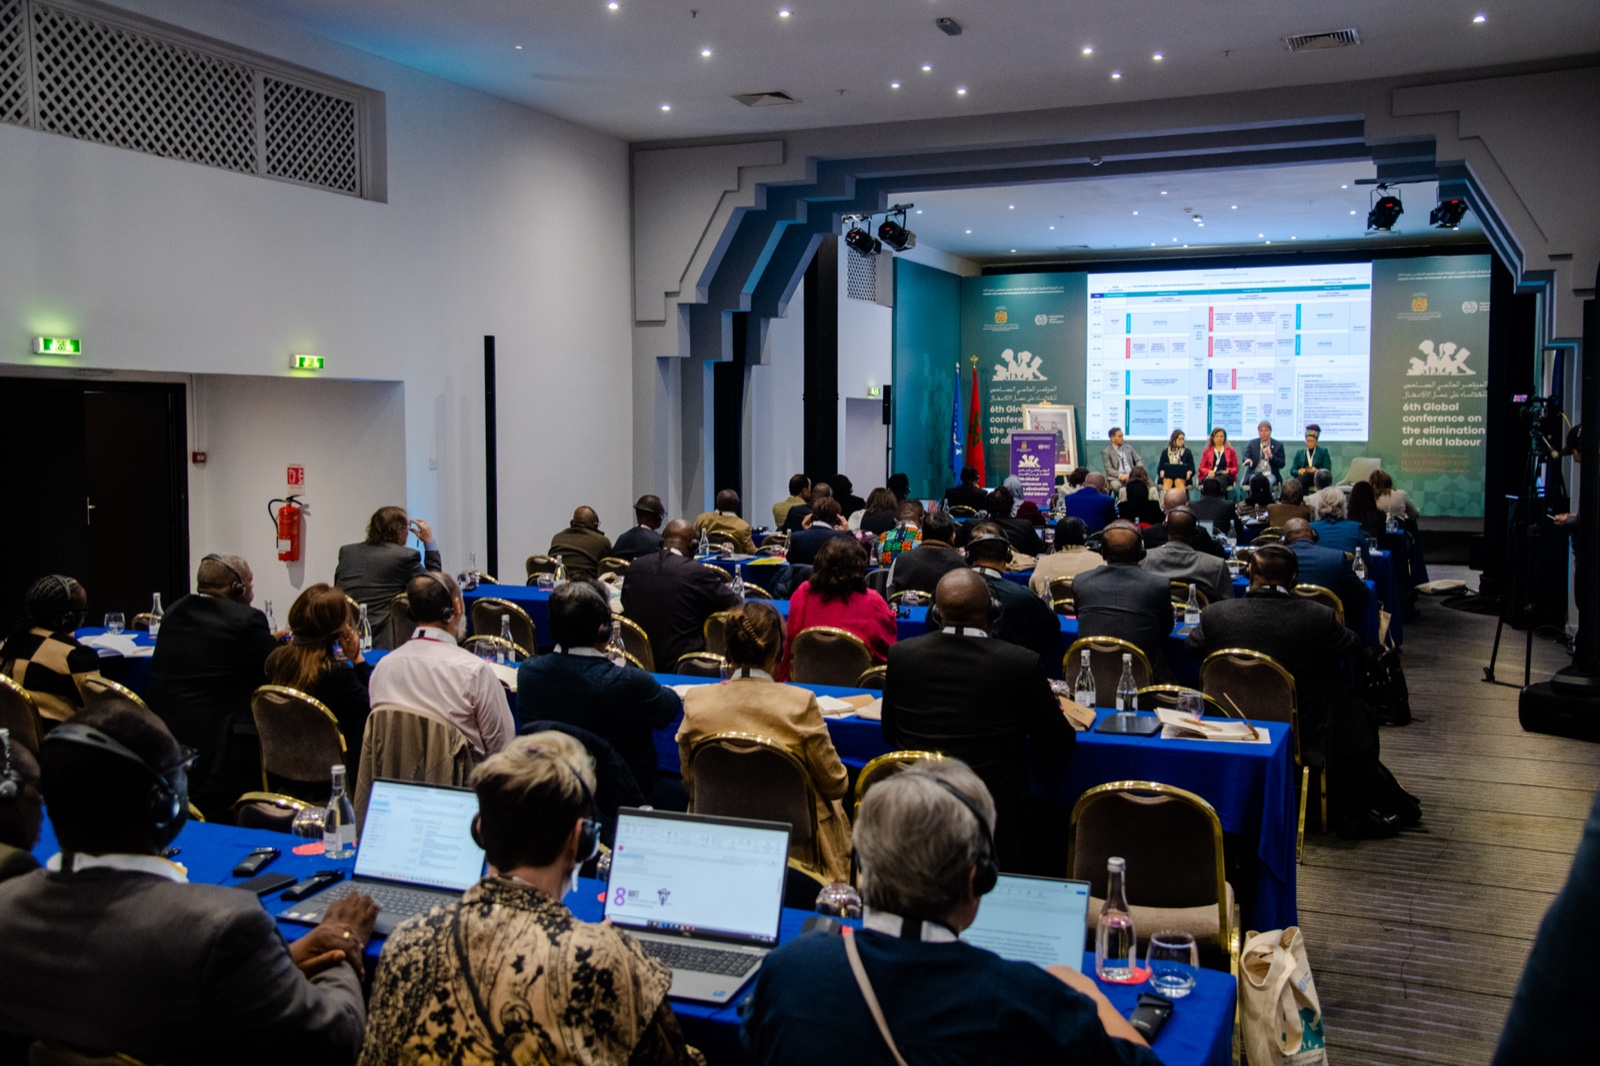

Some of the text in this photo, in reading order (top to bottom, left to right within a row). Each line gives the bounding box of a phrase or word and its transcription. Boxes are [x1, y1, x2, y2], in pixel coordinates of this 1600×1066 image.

[990, 405, 1022, 413] 6th Glo
[1402, 402, 1459, 411] 6th Global
[990, 415, 1023, 423] confere
[1402, 414, 1465, 422] conference
[990, 426, 1006, 434] the
[1402, 425, 1486, 435] the elimination
[990, 436, 999, 444] of
[1402, 437, 1482, 446] of child labour
[614, 886, 626, 906] 8
